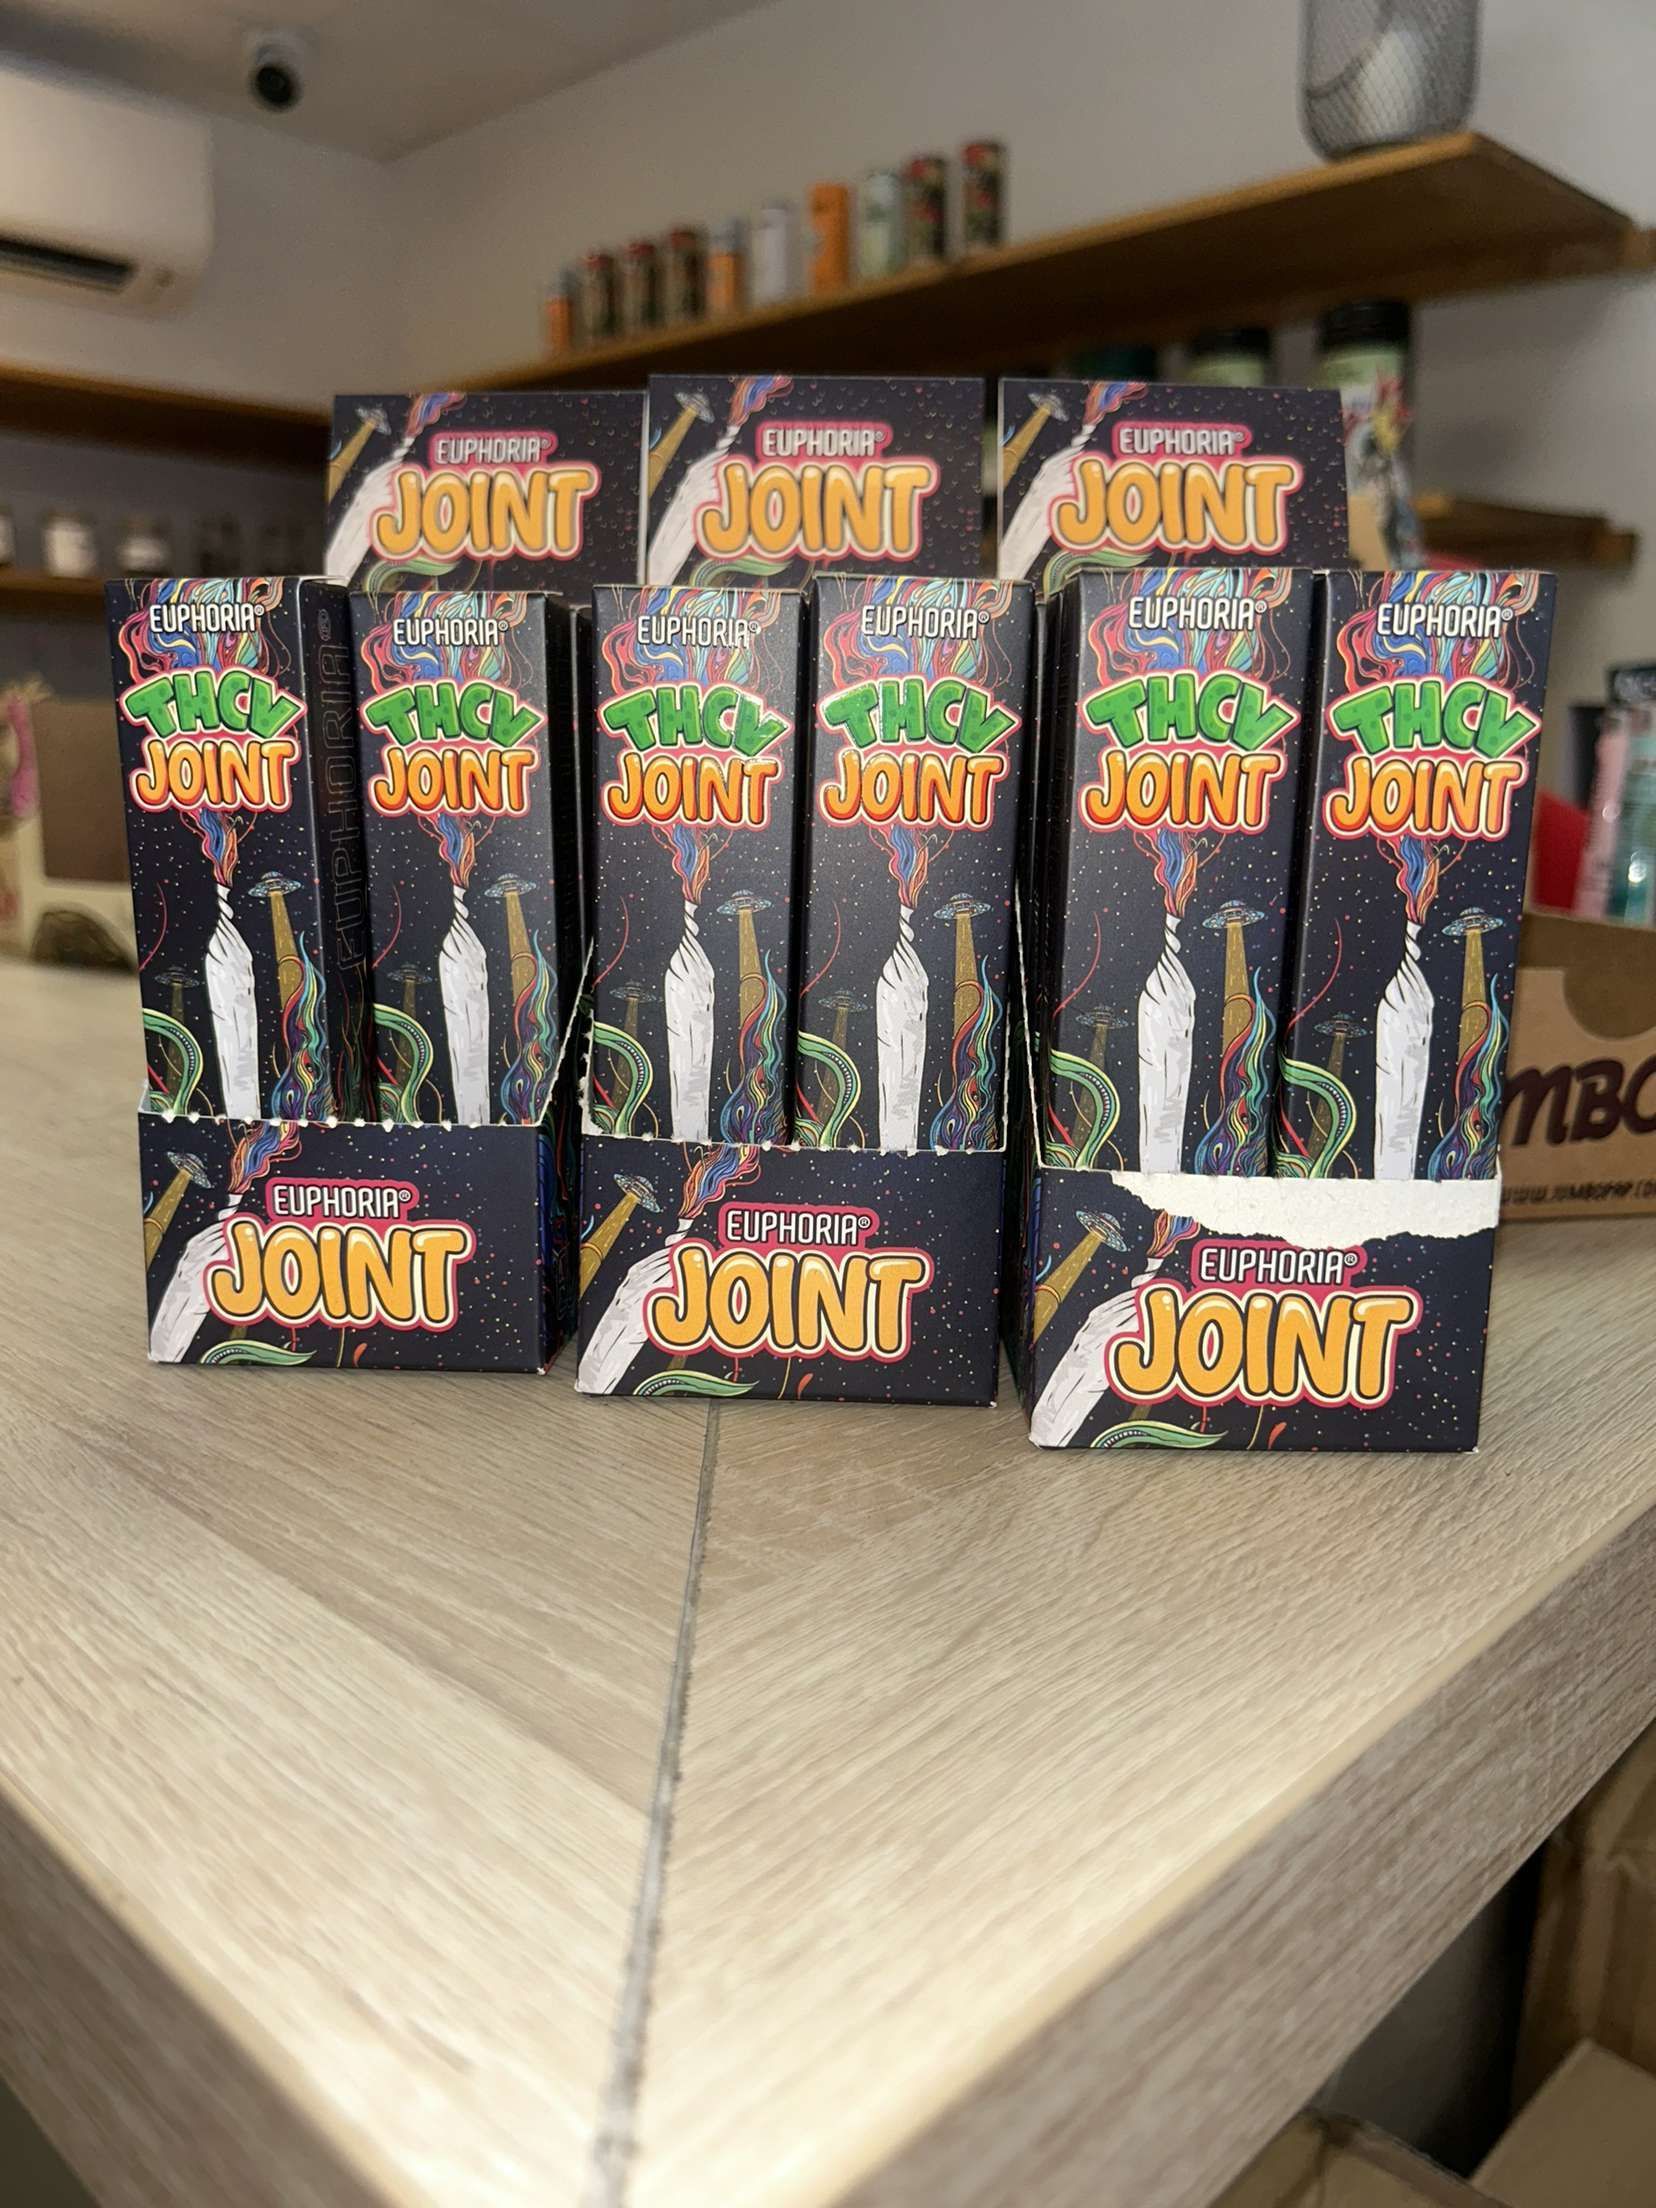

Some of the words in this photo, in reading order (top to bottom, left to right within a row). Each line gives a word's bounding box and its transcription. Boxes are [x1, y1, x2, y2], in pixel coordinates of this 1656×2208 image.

[376, 469, 594, 555] JOINT
[702, 462, 933, 554] JOINT
[1057, 459, 1295, 546] JOINT
[125, 670, 302, 739] THCV
[365, 682, 542, 748] THCV
[603, 685, 789, 757] THCV
[824, 678, 1016, 755] THCV
[1086, 673, 1294, 752] THCV
[1333, 680, 1537, 759] THCV
[135, 739, 296, 807] JOINT
[374, 746, 536, 812] JOINT
[607, 752, 779, 825] JOINT
[824, 749, 1004, 825] JOINT
[1085, 750, 1281, 828] JOINT
[1330, 756, 1523, 835] JOINT
[211, 1220, 468, 1323] JOINT
[651, 1246, 926, 1354] JOINT
[1114, 1286, 1415, 1400] JOINT
